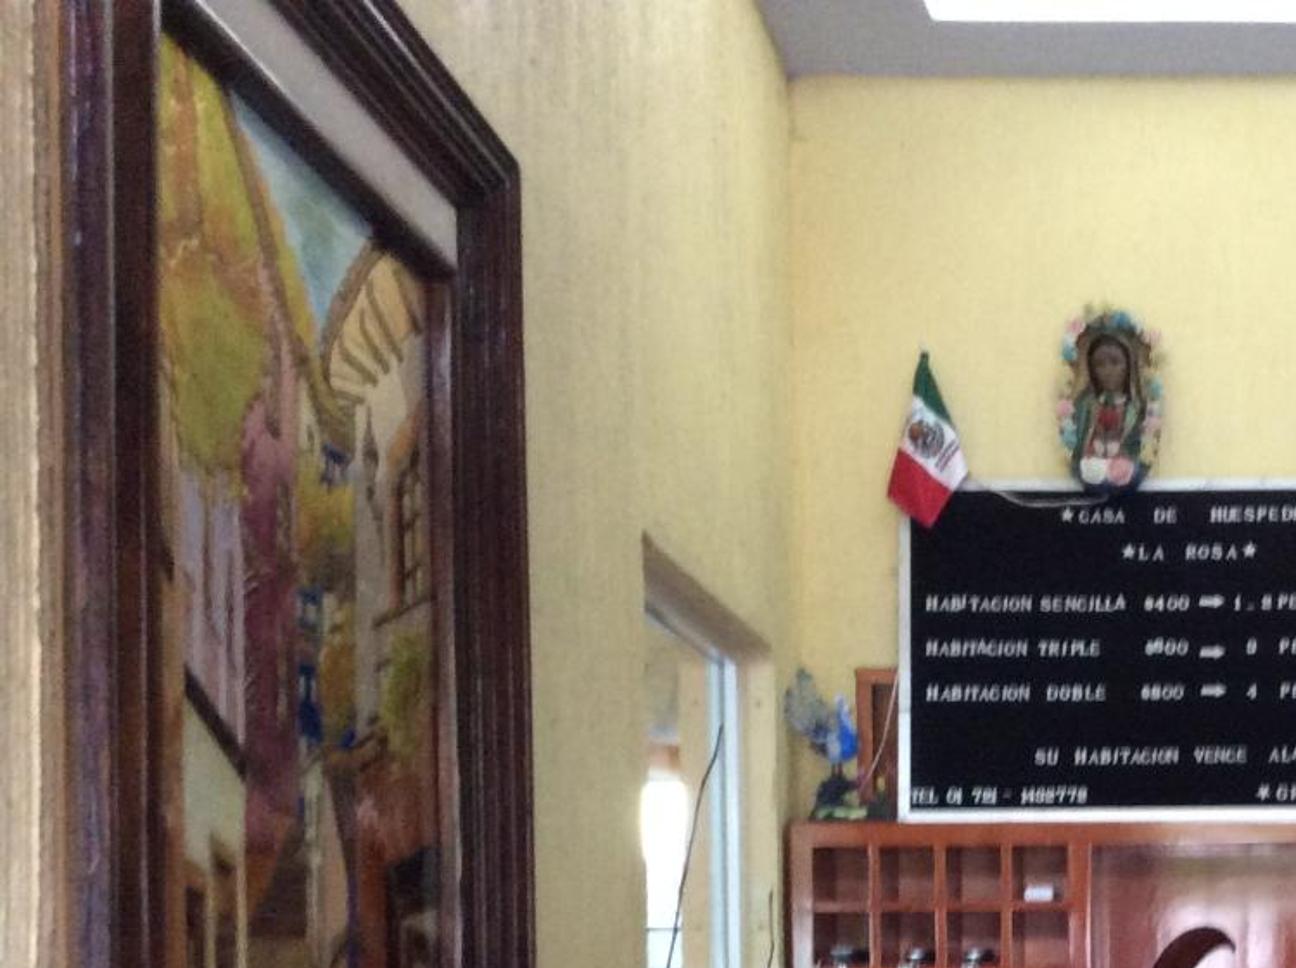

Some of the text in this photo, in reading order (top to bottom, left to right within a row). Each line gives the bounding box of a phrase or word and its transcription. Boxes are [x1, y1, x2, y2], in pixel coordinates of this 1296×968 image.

[1078, 507, 1125, 523] CASA
[1154, 507, 1176, 523] DE
[1139, 543, 1237, 560] LA ROSA
[926, 594, 1032, 612] HABITACION
[1040, 594, 1125, 612] SENCILLA
[926, 638, 1027, 657] HABITACION
[1038, 640, 1099, 656] TRIPLE
[926, 684, 1030, 702] HABITACION
[1047, 684, 1105, 702] DOBLE
[1075, 747, 1179, 765] HABITACION
[1194, 746, 1246, 764] VENCE
